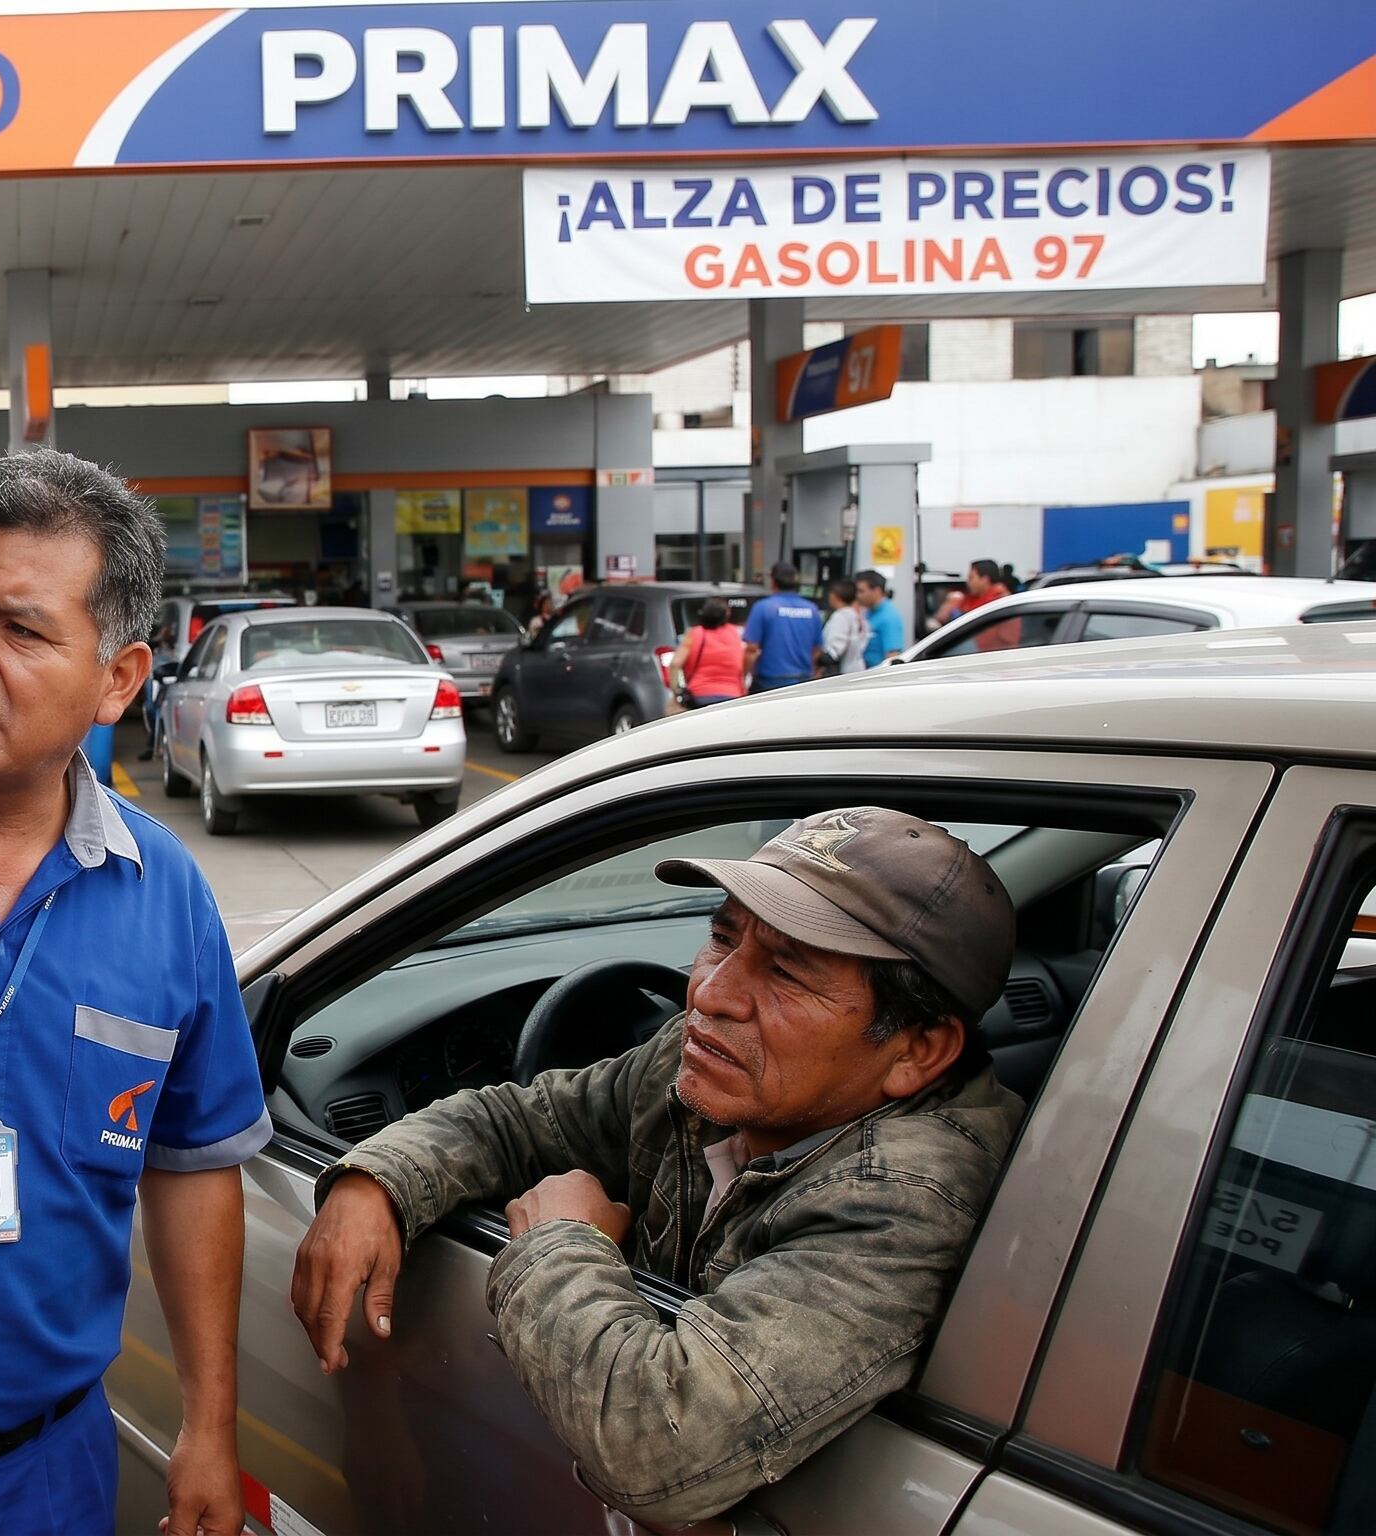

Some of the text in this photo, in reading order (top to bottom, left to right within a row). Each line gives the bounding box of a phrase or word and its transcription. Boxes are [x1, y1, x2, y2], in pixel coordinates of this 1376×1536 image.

[260, 18, 879, 134] PRIMAX
[559, 163, 1236, 242] ¡ALZA DE PRECIOS!
[684, 234, 1105, 290] GASOLINA 97
[847, 345, 876, 394] 97
